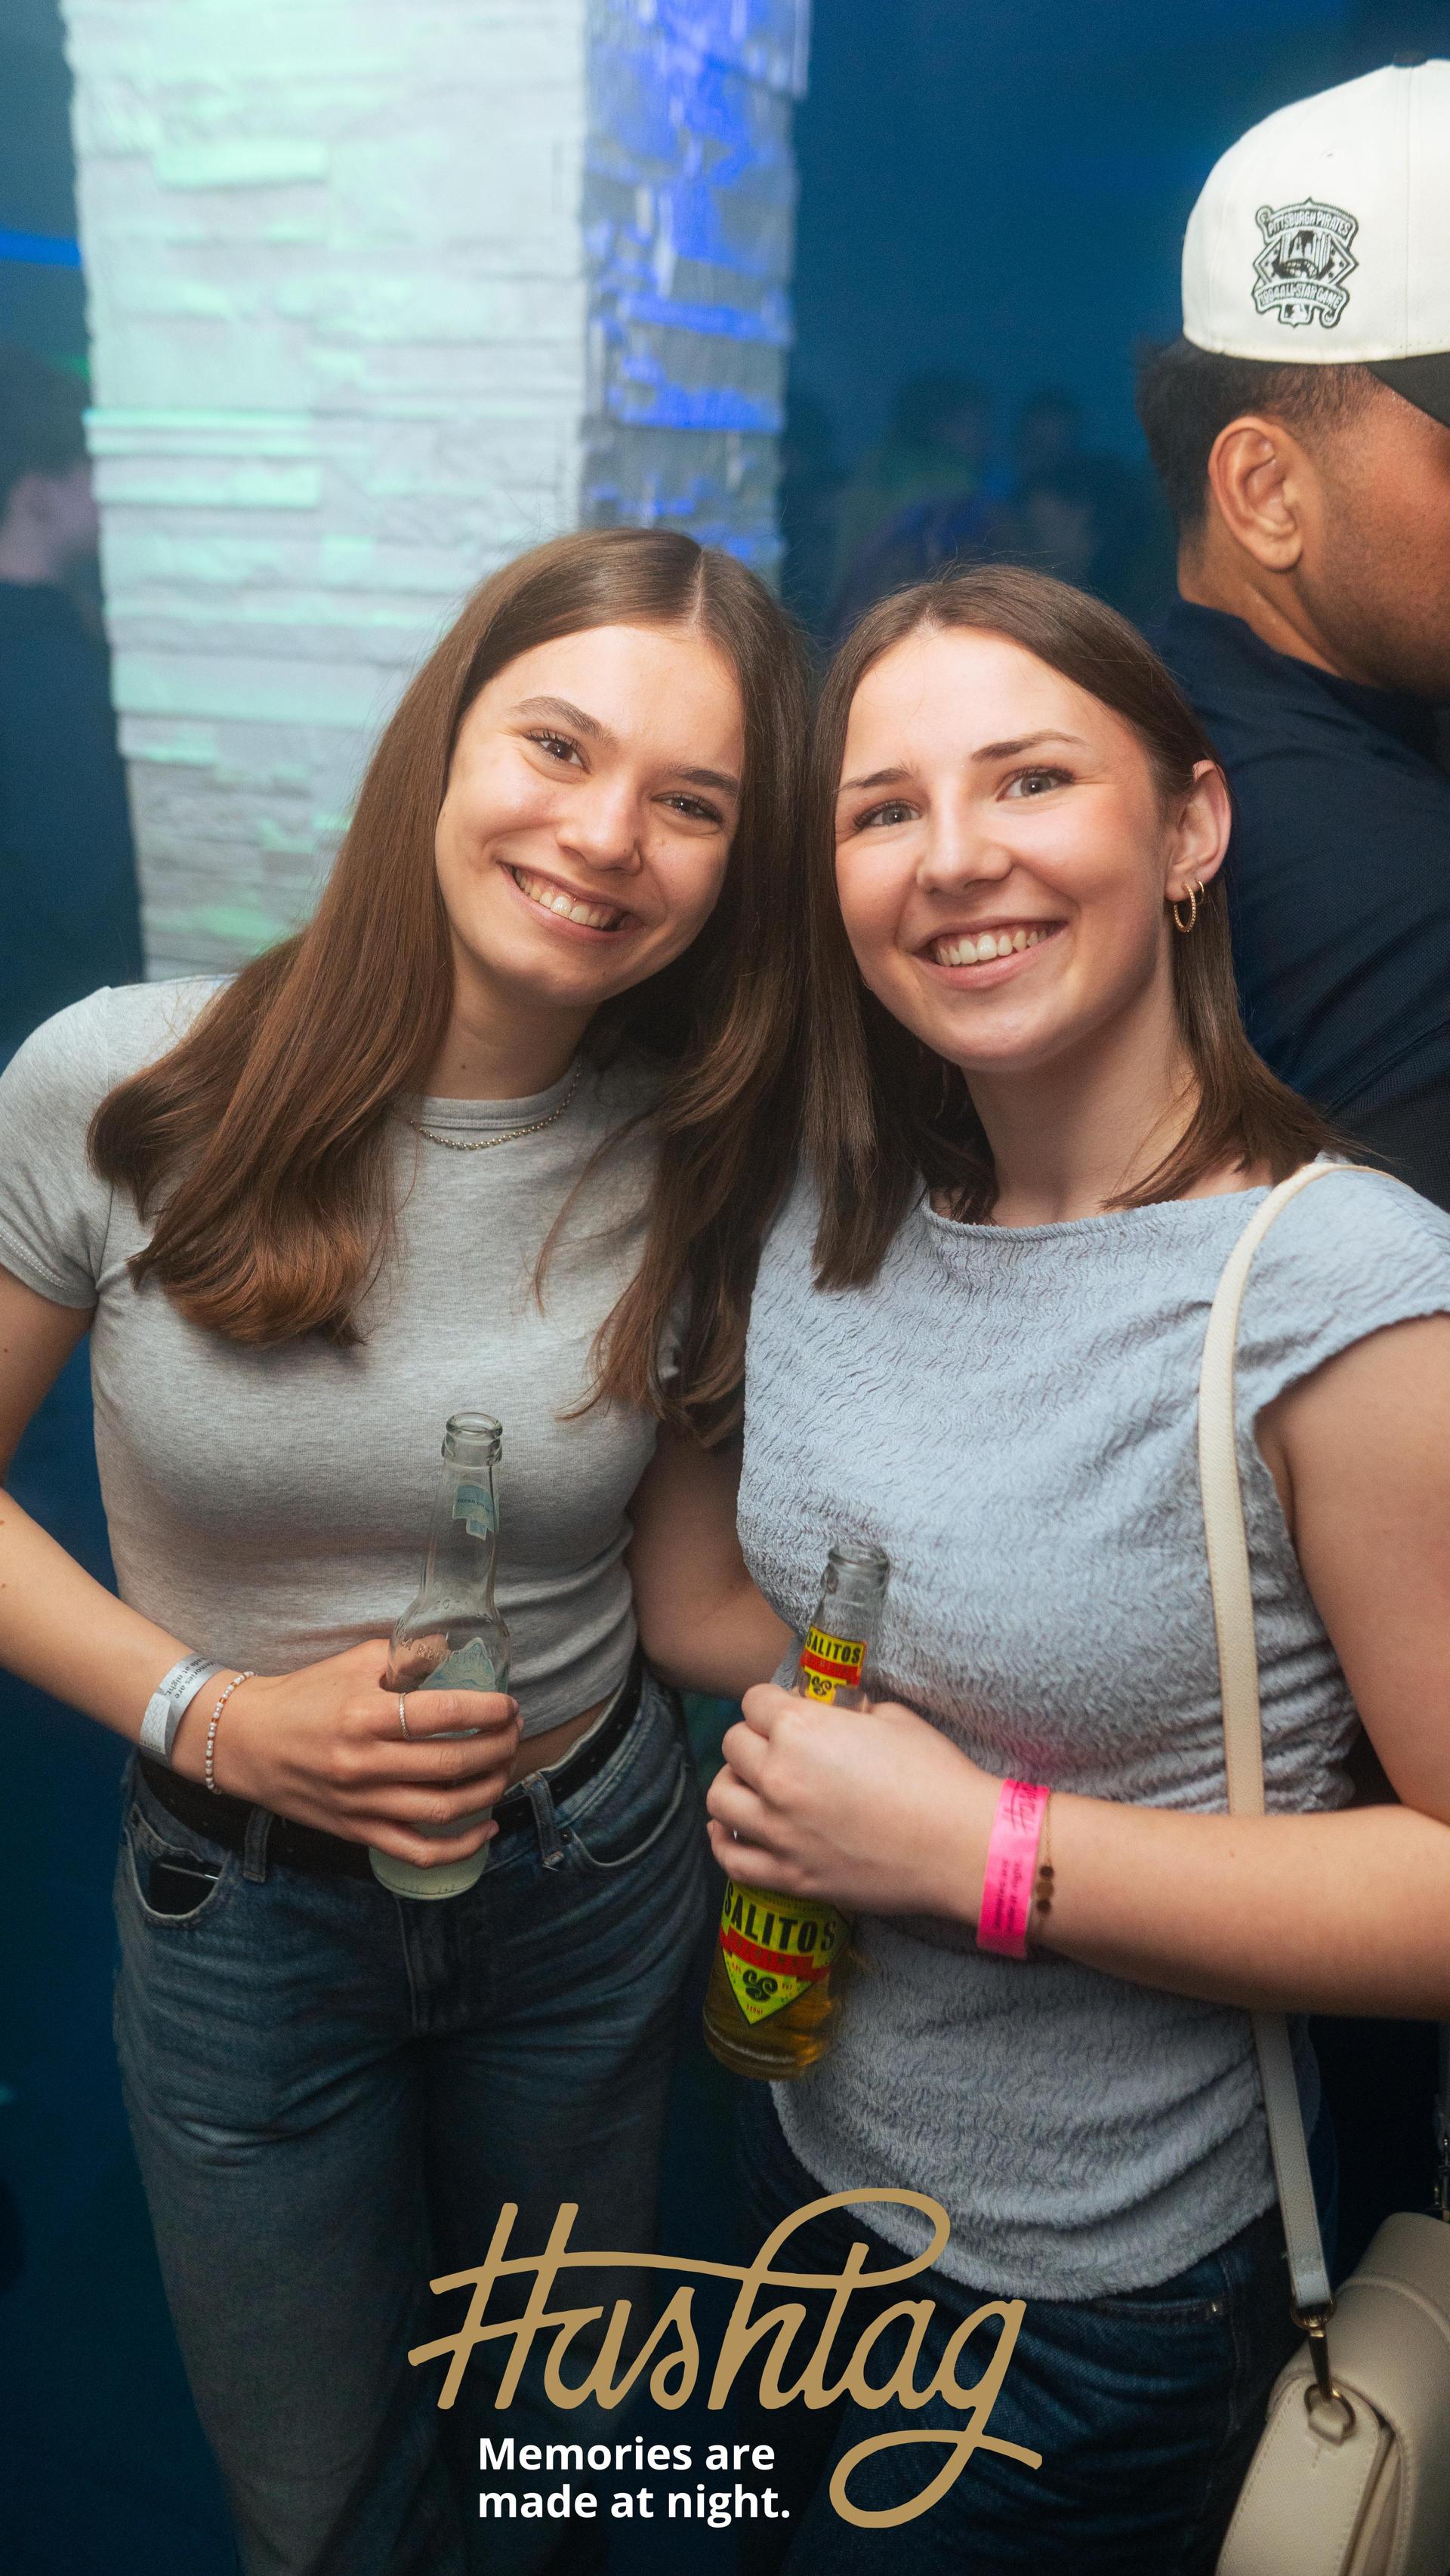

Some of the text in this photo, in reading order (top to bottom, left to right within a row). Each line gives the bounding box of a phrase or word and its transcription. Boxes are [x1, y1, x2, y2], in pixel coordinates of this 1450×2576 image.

[1268, 211, 1350, 236] PITTSBURGH PIRATES
[1316, 287, 1343, 309] GAME
[807, 1631, 861, 1664] SALITOS
[174, 1685, 185, 1699] are
[724, 1880, 836, 1953] SALITOS
